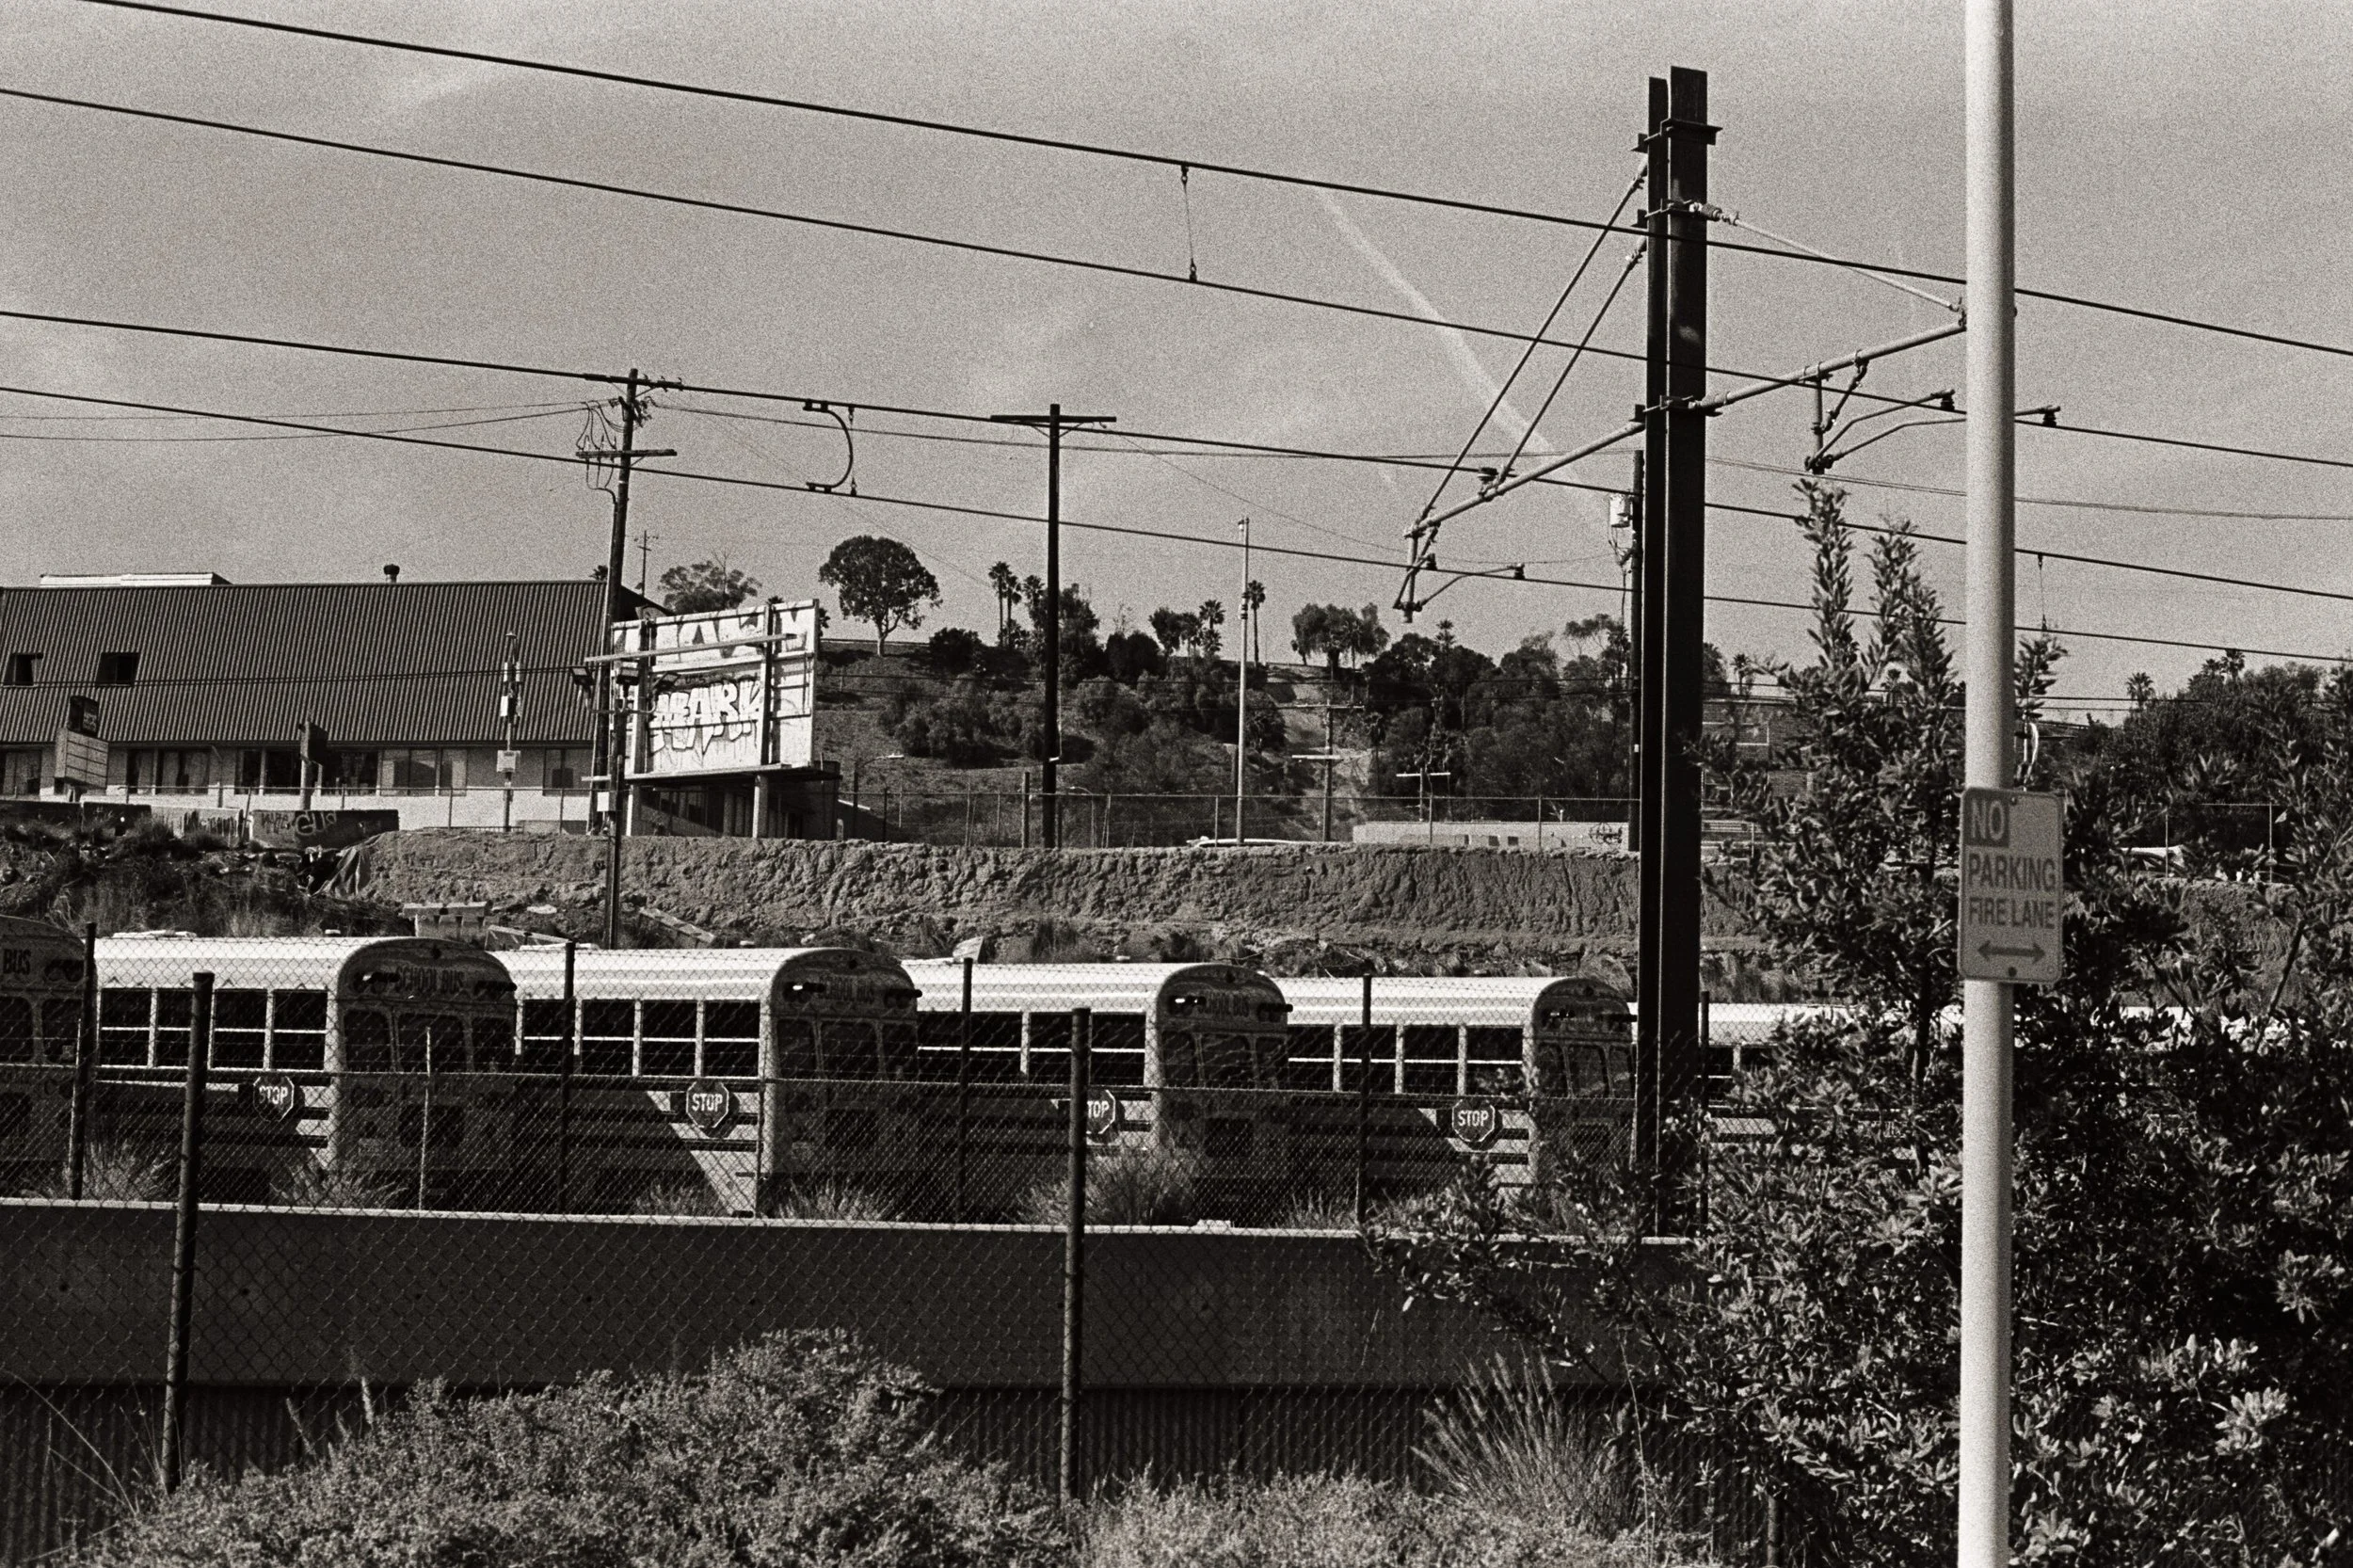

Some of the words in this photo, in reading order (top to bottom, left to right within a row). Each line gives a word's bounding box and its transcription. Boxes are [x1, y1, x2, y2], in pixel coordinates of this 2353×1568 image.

[1972, 798, 2005, 840] NO
[1968, 853, 2057, 891] PARKING
[1968, 896, 2008, 926] FIRE
[2011, 900, 2056, 930] LANE
[3, 948, 32, 975] BUS
[395, 966, 437, 993] SCHOOL
[440, 969, 465, 994] BUS
[259, 1085, 288, 1104] STOP
[692, 1093, 723, 1112] STOP
[1086, 1100, 1110, 1118] TOP
[1457, 1111, 1489, 1127] STOP
